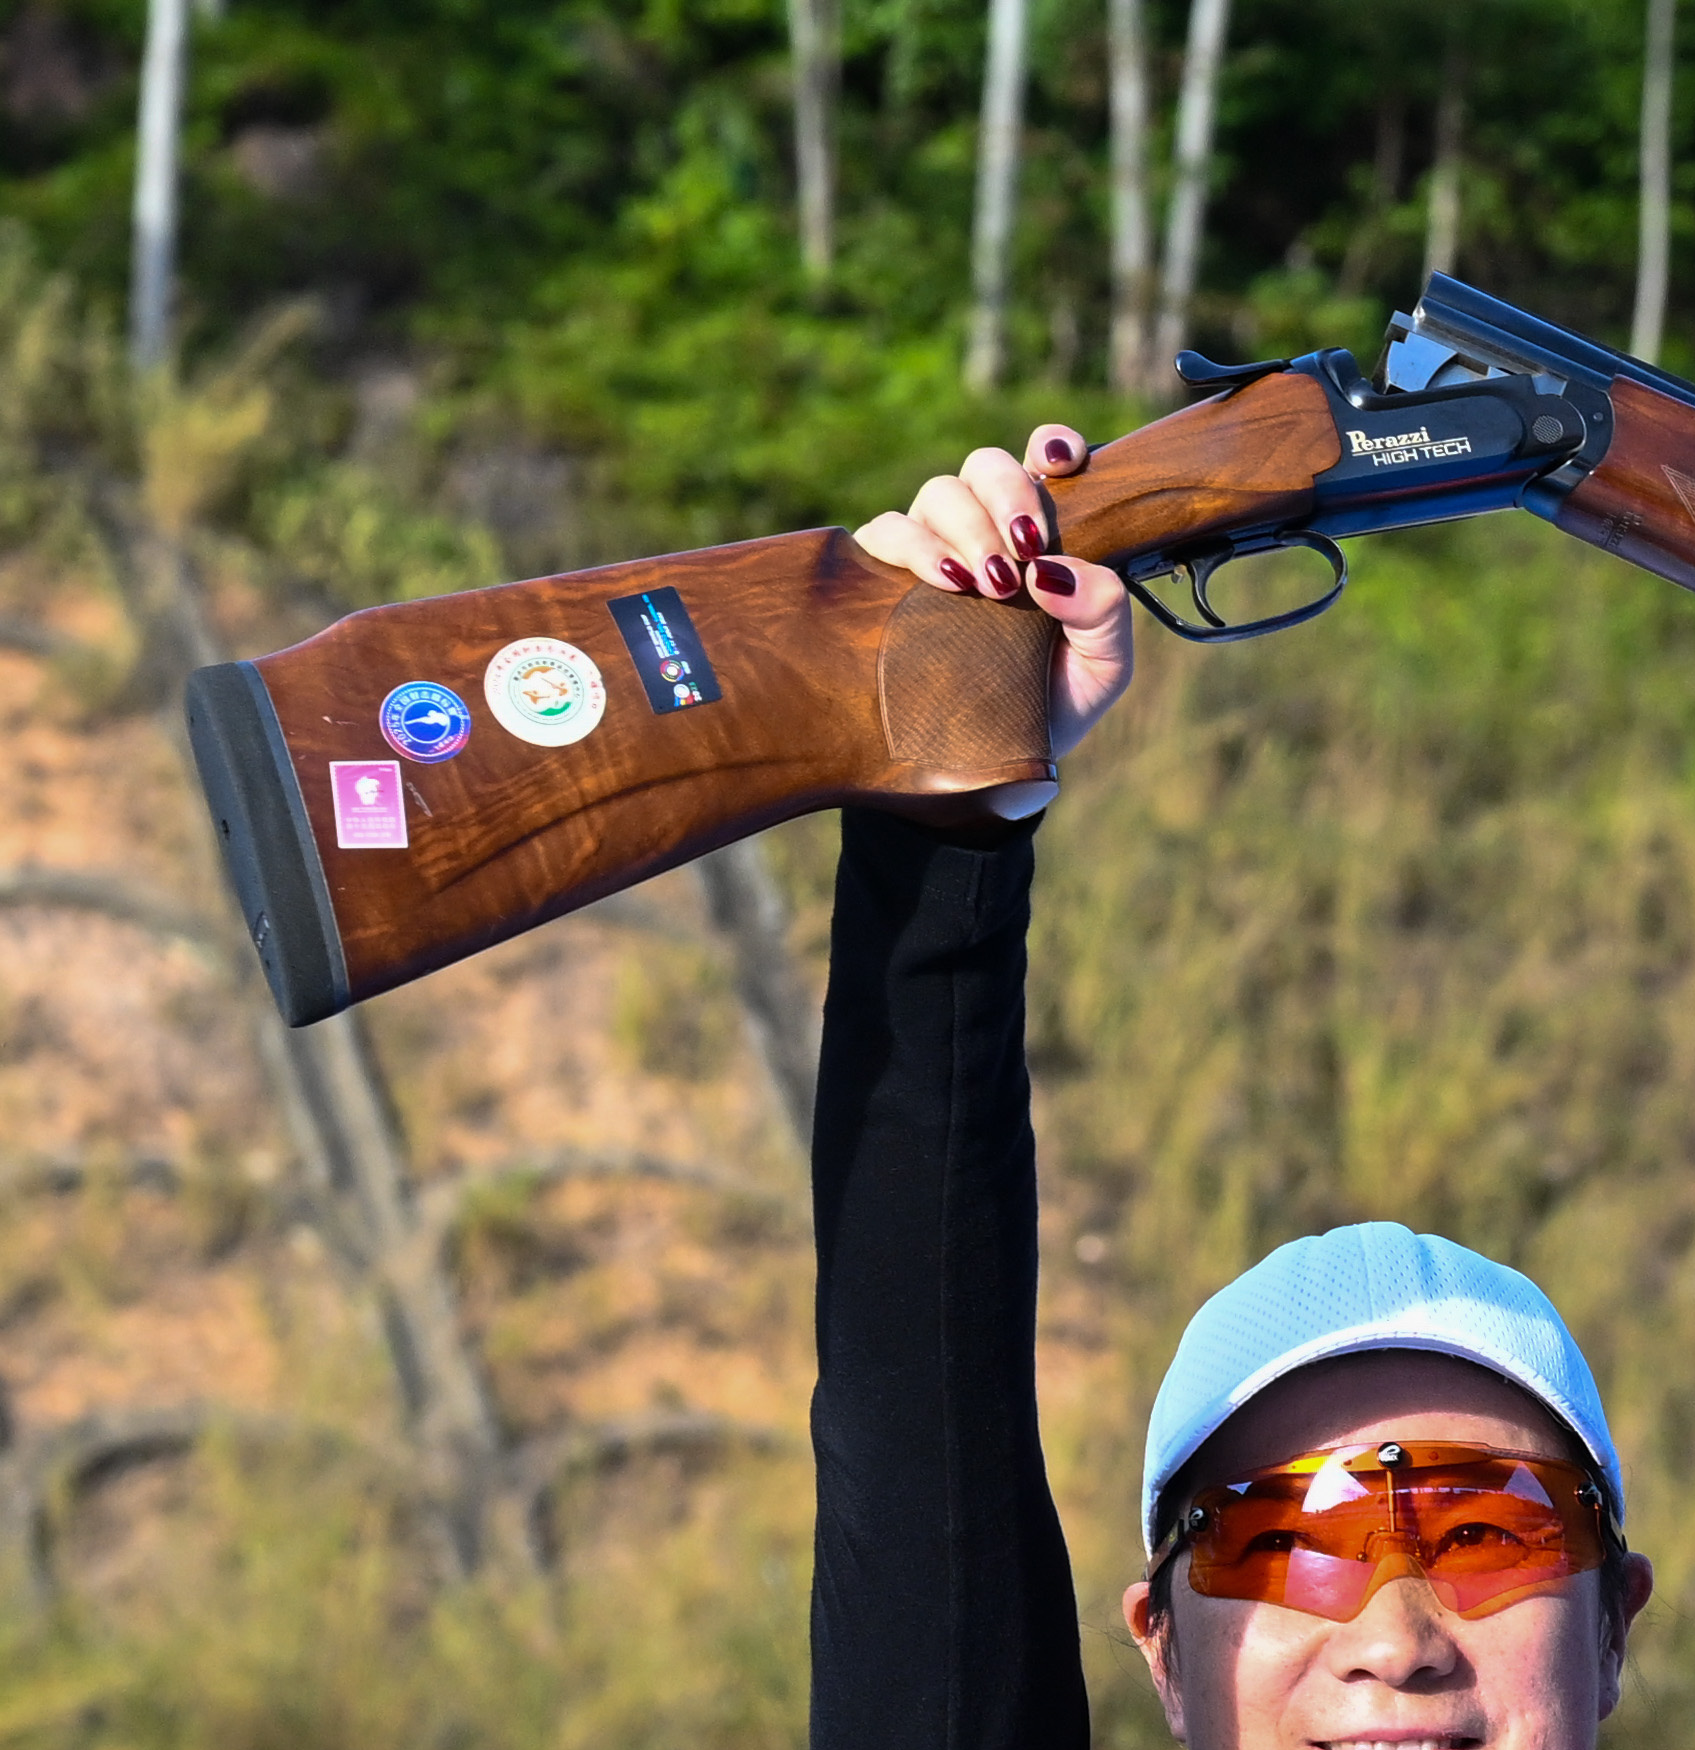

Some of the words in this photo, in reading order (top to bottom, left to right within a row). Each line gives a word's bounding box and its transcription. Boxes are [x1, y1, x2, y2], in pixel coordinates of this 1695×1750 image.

[1346, 426, 1431, 452] Perazzi
[1373, 448, 1419, 467] HIGH
[1424, 439, 1472, 460] TECH
